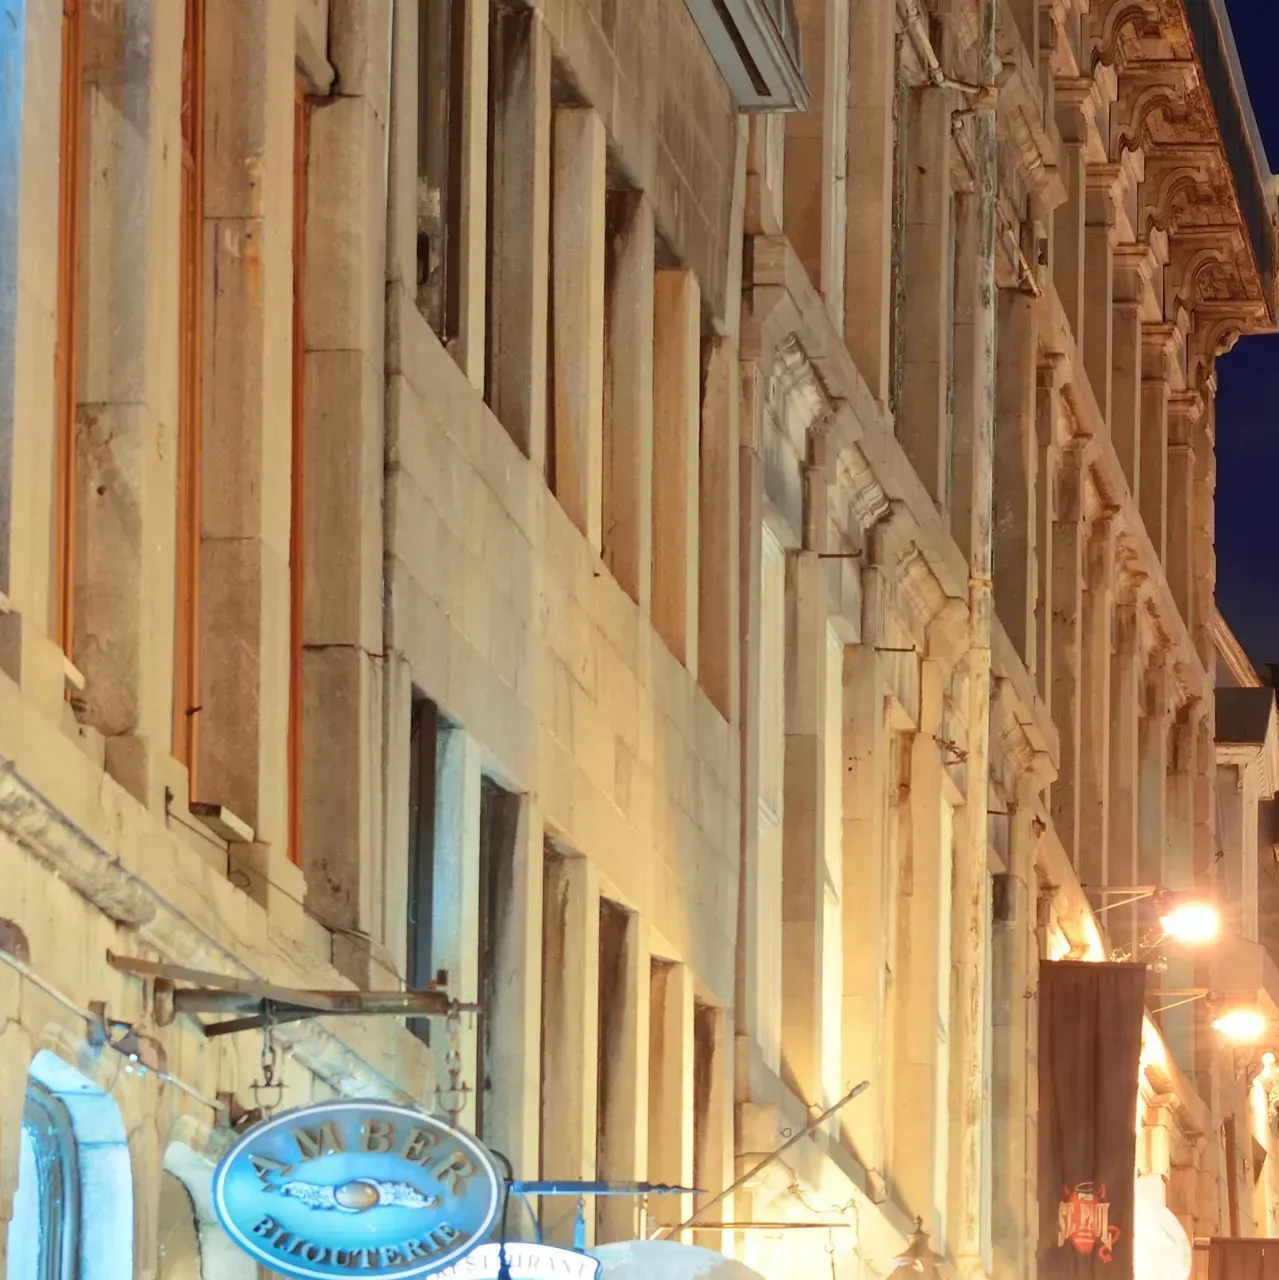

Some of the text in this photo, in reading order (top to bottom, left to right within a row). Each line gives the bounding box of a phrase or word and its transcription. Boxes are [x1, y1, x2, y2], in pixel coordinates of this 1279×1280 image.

[249, 1118, 478, 1197] AMBER
[1078, 1192, 1094, 1201] PUB
[251, 1214, 461, 1269] BIJOUTERIE
[1080, 1203, 1112, 1253] PAUL
